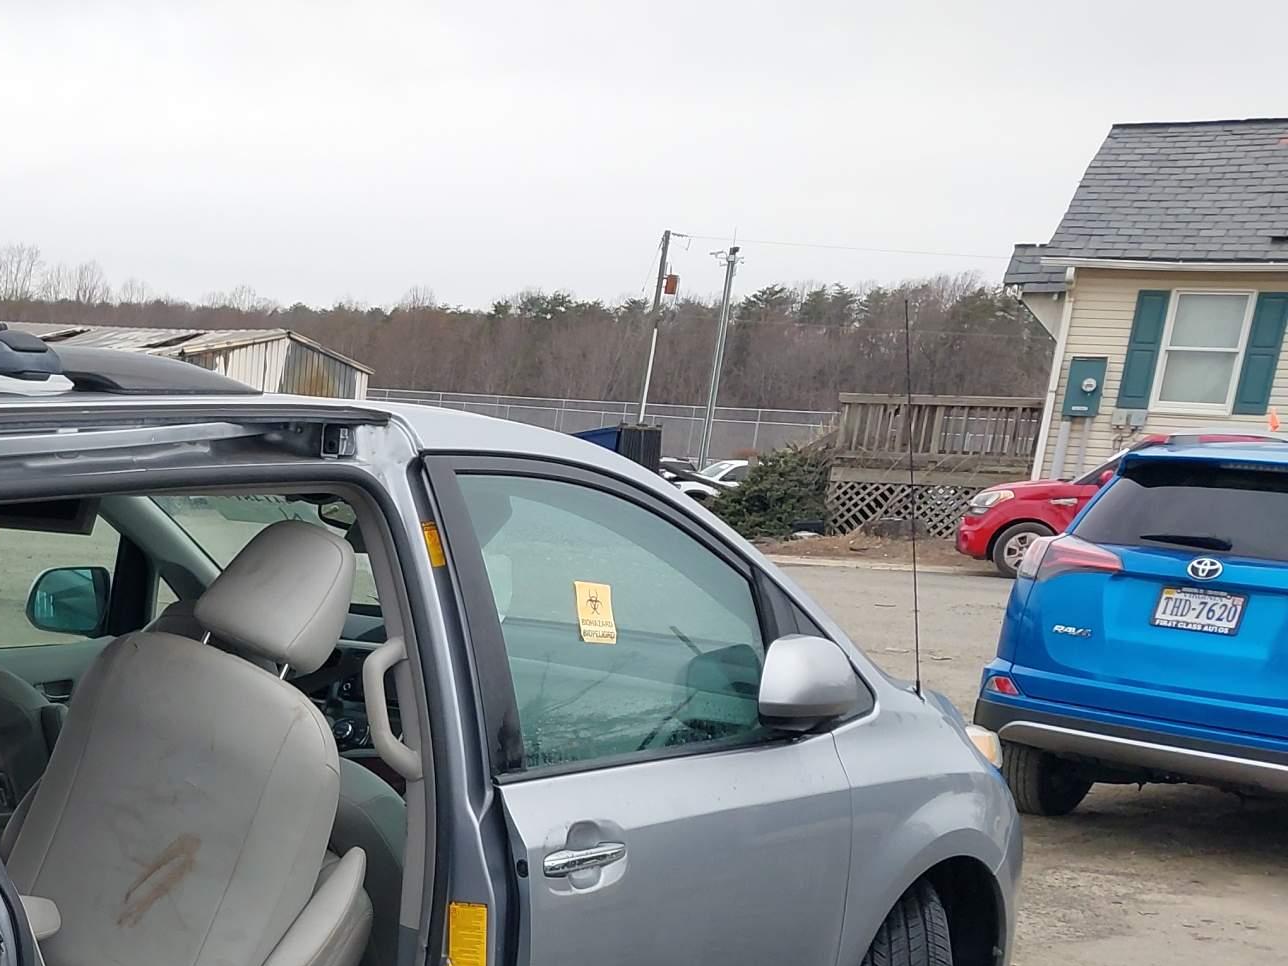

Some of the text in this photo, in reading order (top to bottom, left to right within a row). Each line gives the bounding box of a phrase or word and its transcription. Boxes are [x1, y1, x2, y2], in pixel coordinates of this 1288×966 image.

[1161, 596, 1238, 623] THD-7620
[1155, 619, 1229, 634] FIRST CLASS AUTOS
